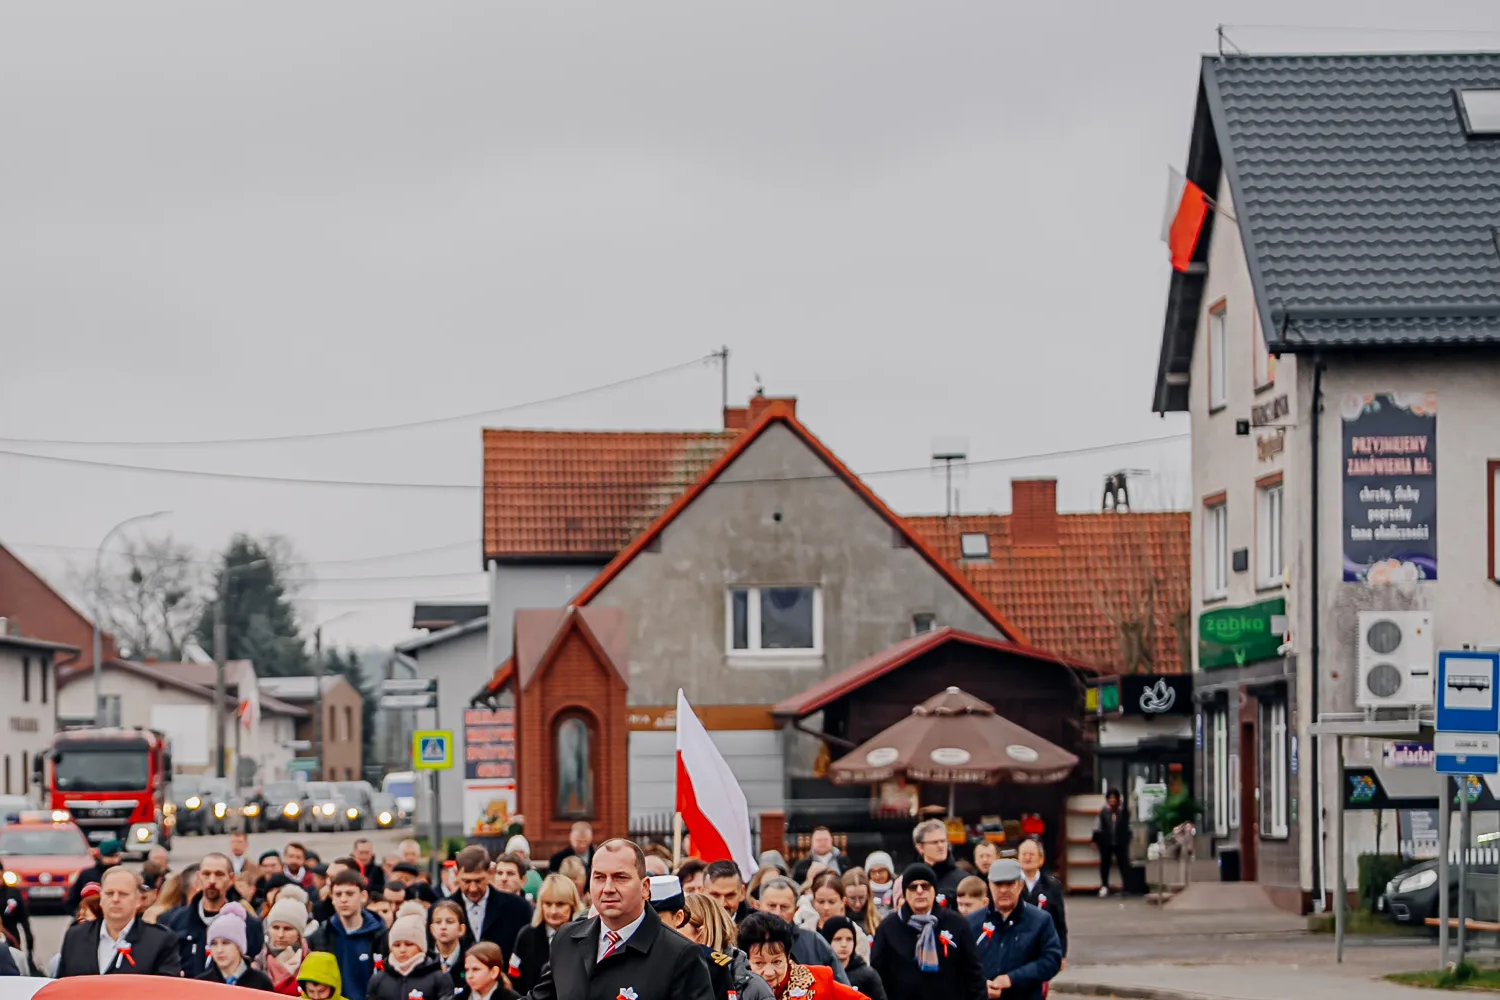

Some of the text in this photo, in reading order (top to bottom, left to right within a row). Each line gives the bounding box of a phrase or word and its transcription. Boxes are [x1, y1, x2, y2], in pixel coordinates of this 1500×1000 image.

[1352, 435, 1428, 455] PRZYJMUJEMY
[1347, 455, 1433, 476] ZAMÓWIENIA NA:
[1351, 523, 1429, 541] inne okoliczności
[1206, 615, 1265, 632] żabka
